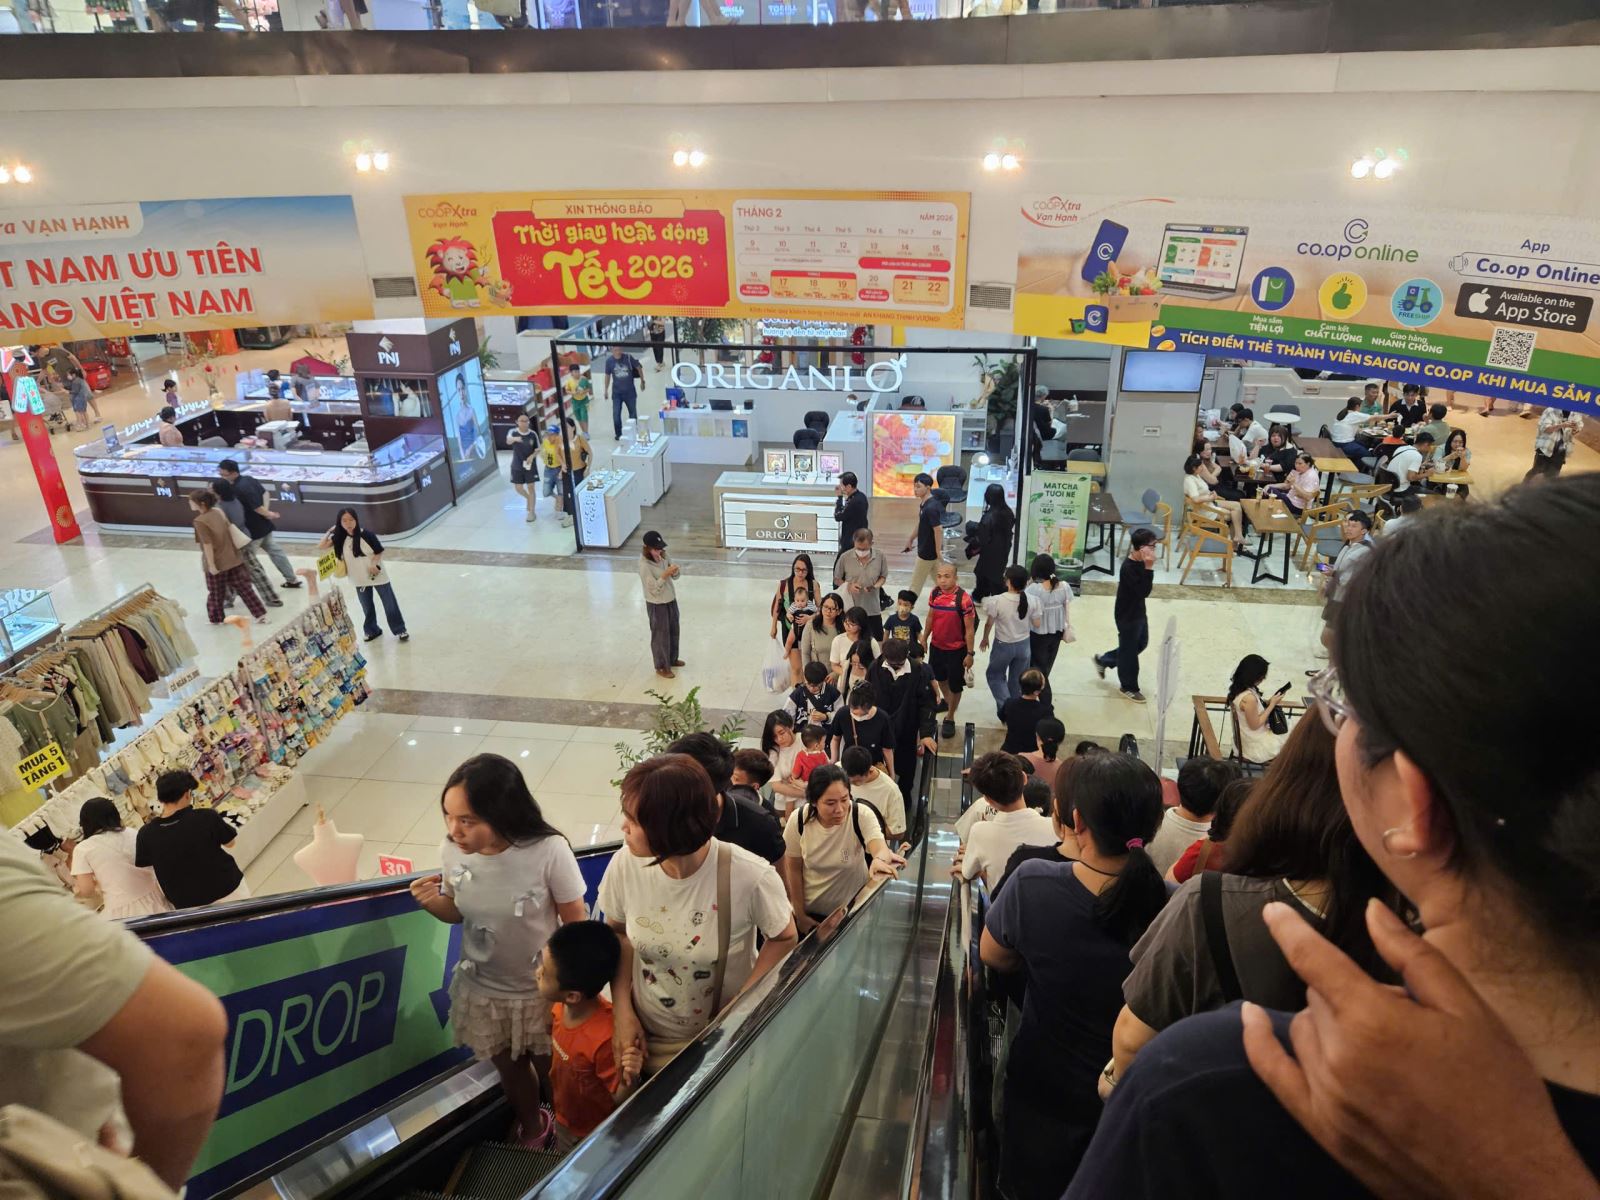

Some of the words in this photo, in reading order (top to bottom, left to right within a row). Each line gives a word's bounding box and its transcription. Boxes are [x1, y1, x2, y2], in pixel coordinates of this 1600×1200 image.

[565, 205, 585, 214] XIN
[588, 202, 627, 215] THÔNG
[629, 201, 653, 214] BÁO
[737, 206, 774, 218] THÁNG
[775, 208, 783, 218] 2
[22, 218, 67, 237] VẠN
[72, 215, 130, 234] HẠNH
[513, 220, 561, 247] Thời
[565, 222, 608, 245] gian
[611, 221, 657, 246] hoạt
[661, 222, 710, 245] động
[1520, 239, 1551, 254] App
[26, 254, 120, 286] NAM
[128, 248, 179, 278] ƯU
[187, 241, 263, 275] TIÊN
[1476, 258, 1530, 279] Co.op
[1536, 264, 1600, 285] Online
[542, 248, 653, 299] Tết
[628, 255, 695, 279] 2026
[81, 286, 156, 327] VIỆT
[168, 288, 254, 316] NAM
[1500, 291, 1543, 304] Available
[1543, 297, 1558, 306] on
[1559, 298, 1576, 309] the
[1253, 315, 1267, 324] Mua
[1495, 302, 1530, 321] App
[1533, 306, 1577, 326] Store
[1250, 322, 1268, 333] TIỆN
[1330, 331, 1362, 343] LƯỢNG
[1390, 332, 1407, 341] Giao
[449, 340, 461, 356] PNJ
[1371, 337, 1406, 349] NHANH
[1408, 340, 1443, 354] CHÓNG
[378, 351, 400, 367] PNJ
[1180, 332, 1209, 346] TÍCH
[1212, 334, 1245, 350] ĐIỂM
[1248, 339, 1273, 354] THẺ
[1277, 343, 1325, 360] THÀNH
[1329, 350, 1361, 365] VIÊN
[1363, 356, 1421, 374] SAIGON
[1424, 364, 1473, 382] CO.OP
[1478, 373, 1506, 388] KHI
[1510, 379, 1548, 396] MUA
[1552, 383, 1591, 404] SẮM
[671, 362, 852, 392] ORIGANI
[156, 487, 172, 497] PNJ
[1043, 482, 1078, 490] MATCHA
[756, 530, 807, 540] ORIGANI
[18, 753, 48, 774] MUA
[49, 746, 58, 756] 5
[22, 762, 58, 786] TẶNG
[56, 756, 65, 766] 1
[225, 971, 386, 1095] DROP
